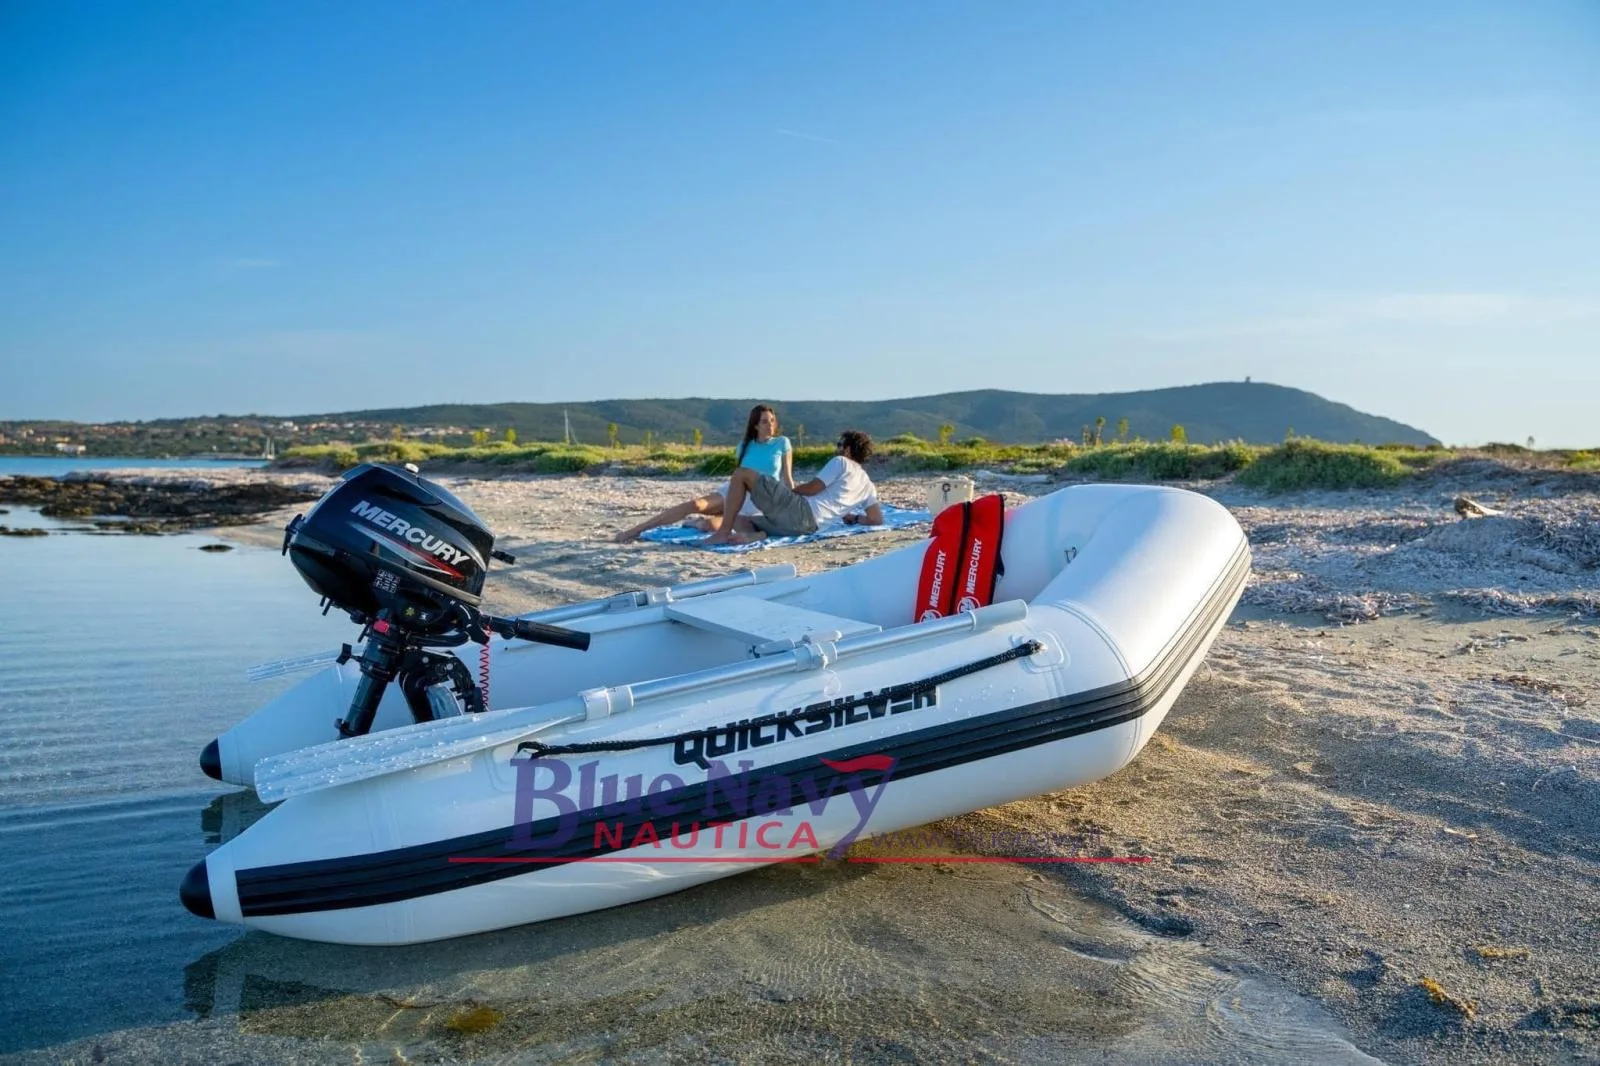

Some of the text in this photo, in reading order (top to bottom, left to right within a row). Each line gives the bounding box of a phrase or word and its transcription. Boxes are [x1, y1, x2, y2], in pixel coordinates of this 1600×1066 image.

[351, 501, 470, 565] MERCURY
[930, 550, 947, 607] MERCURY
[966, 538, 982, 594] MERCURY
